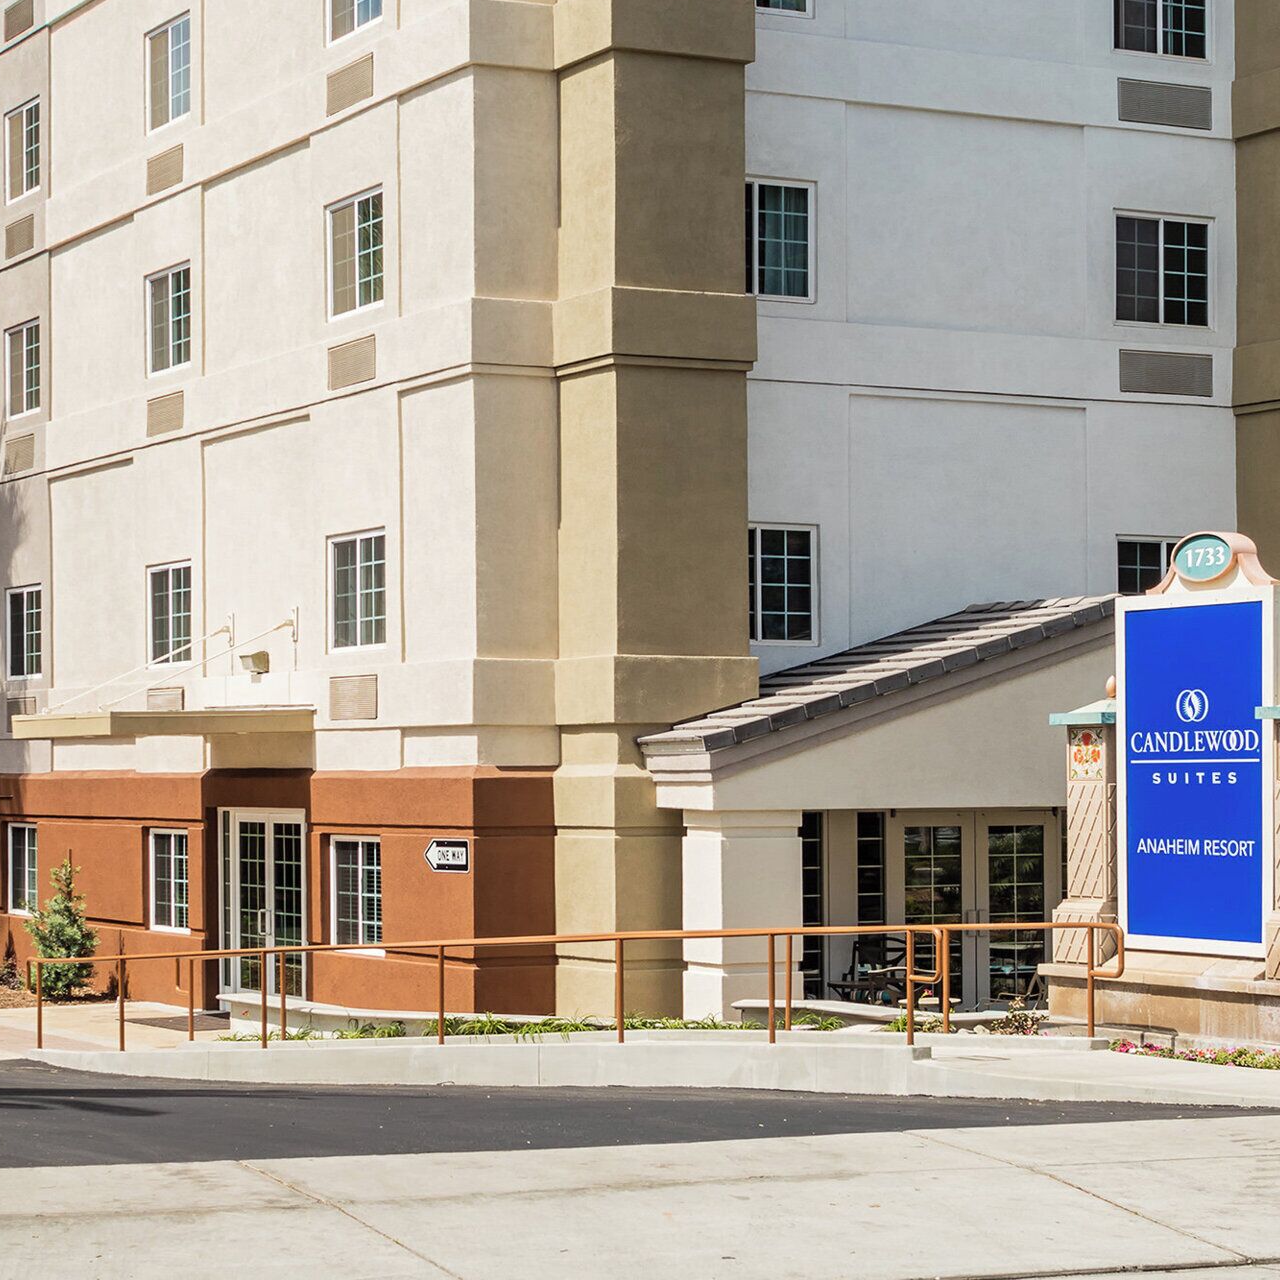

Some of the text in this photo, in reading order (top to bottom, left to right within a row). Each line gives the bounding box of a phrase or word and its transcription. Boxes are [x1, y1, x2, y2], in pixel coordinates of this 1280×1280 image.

[1185, 545, 1225, 568] 1733
[1130, 730, 1259, 753] CANDLEWOOD
[1152, 771, 1237, 785] SUITES
[437, 850, 464, 862] ONE WAY
[1137, 838, 1255, 857] ANAHEIM RESORT
